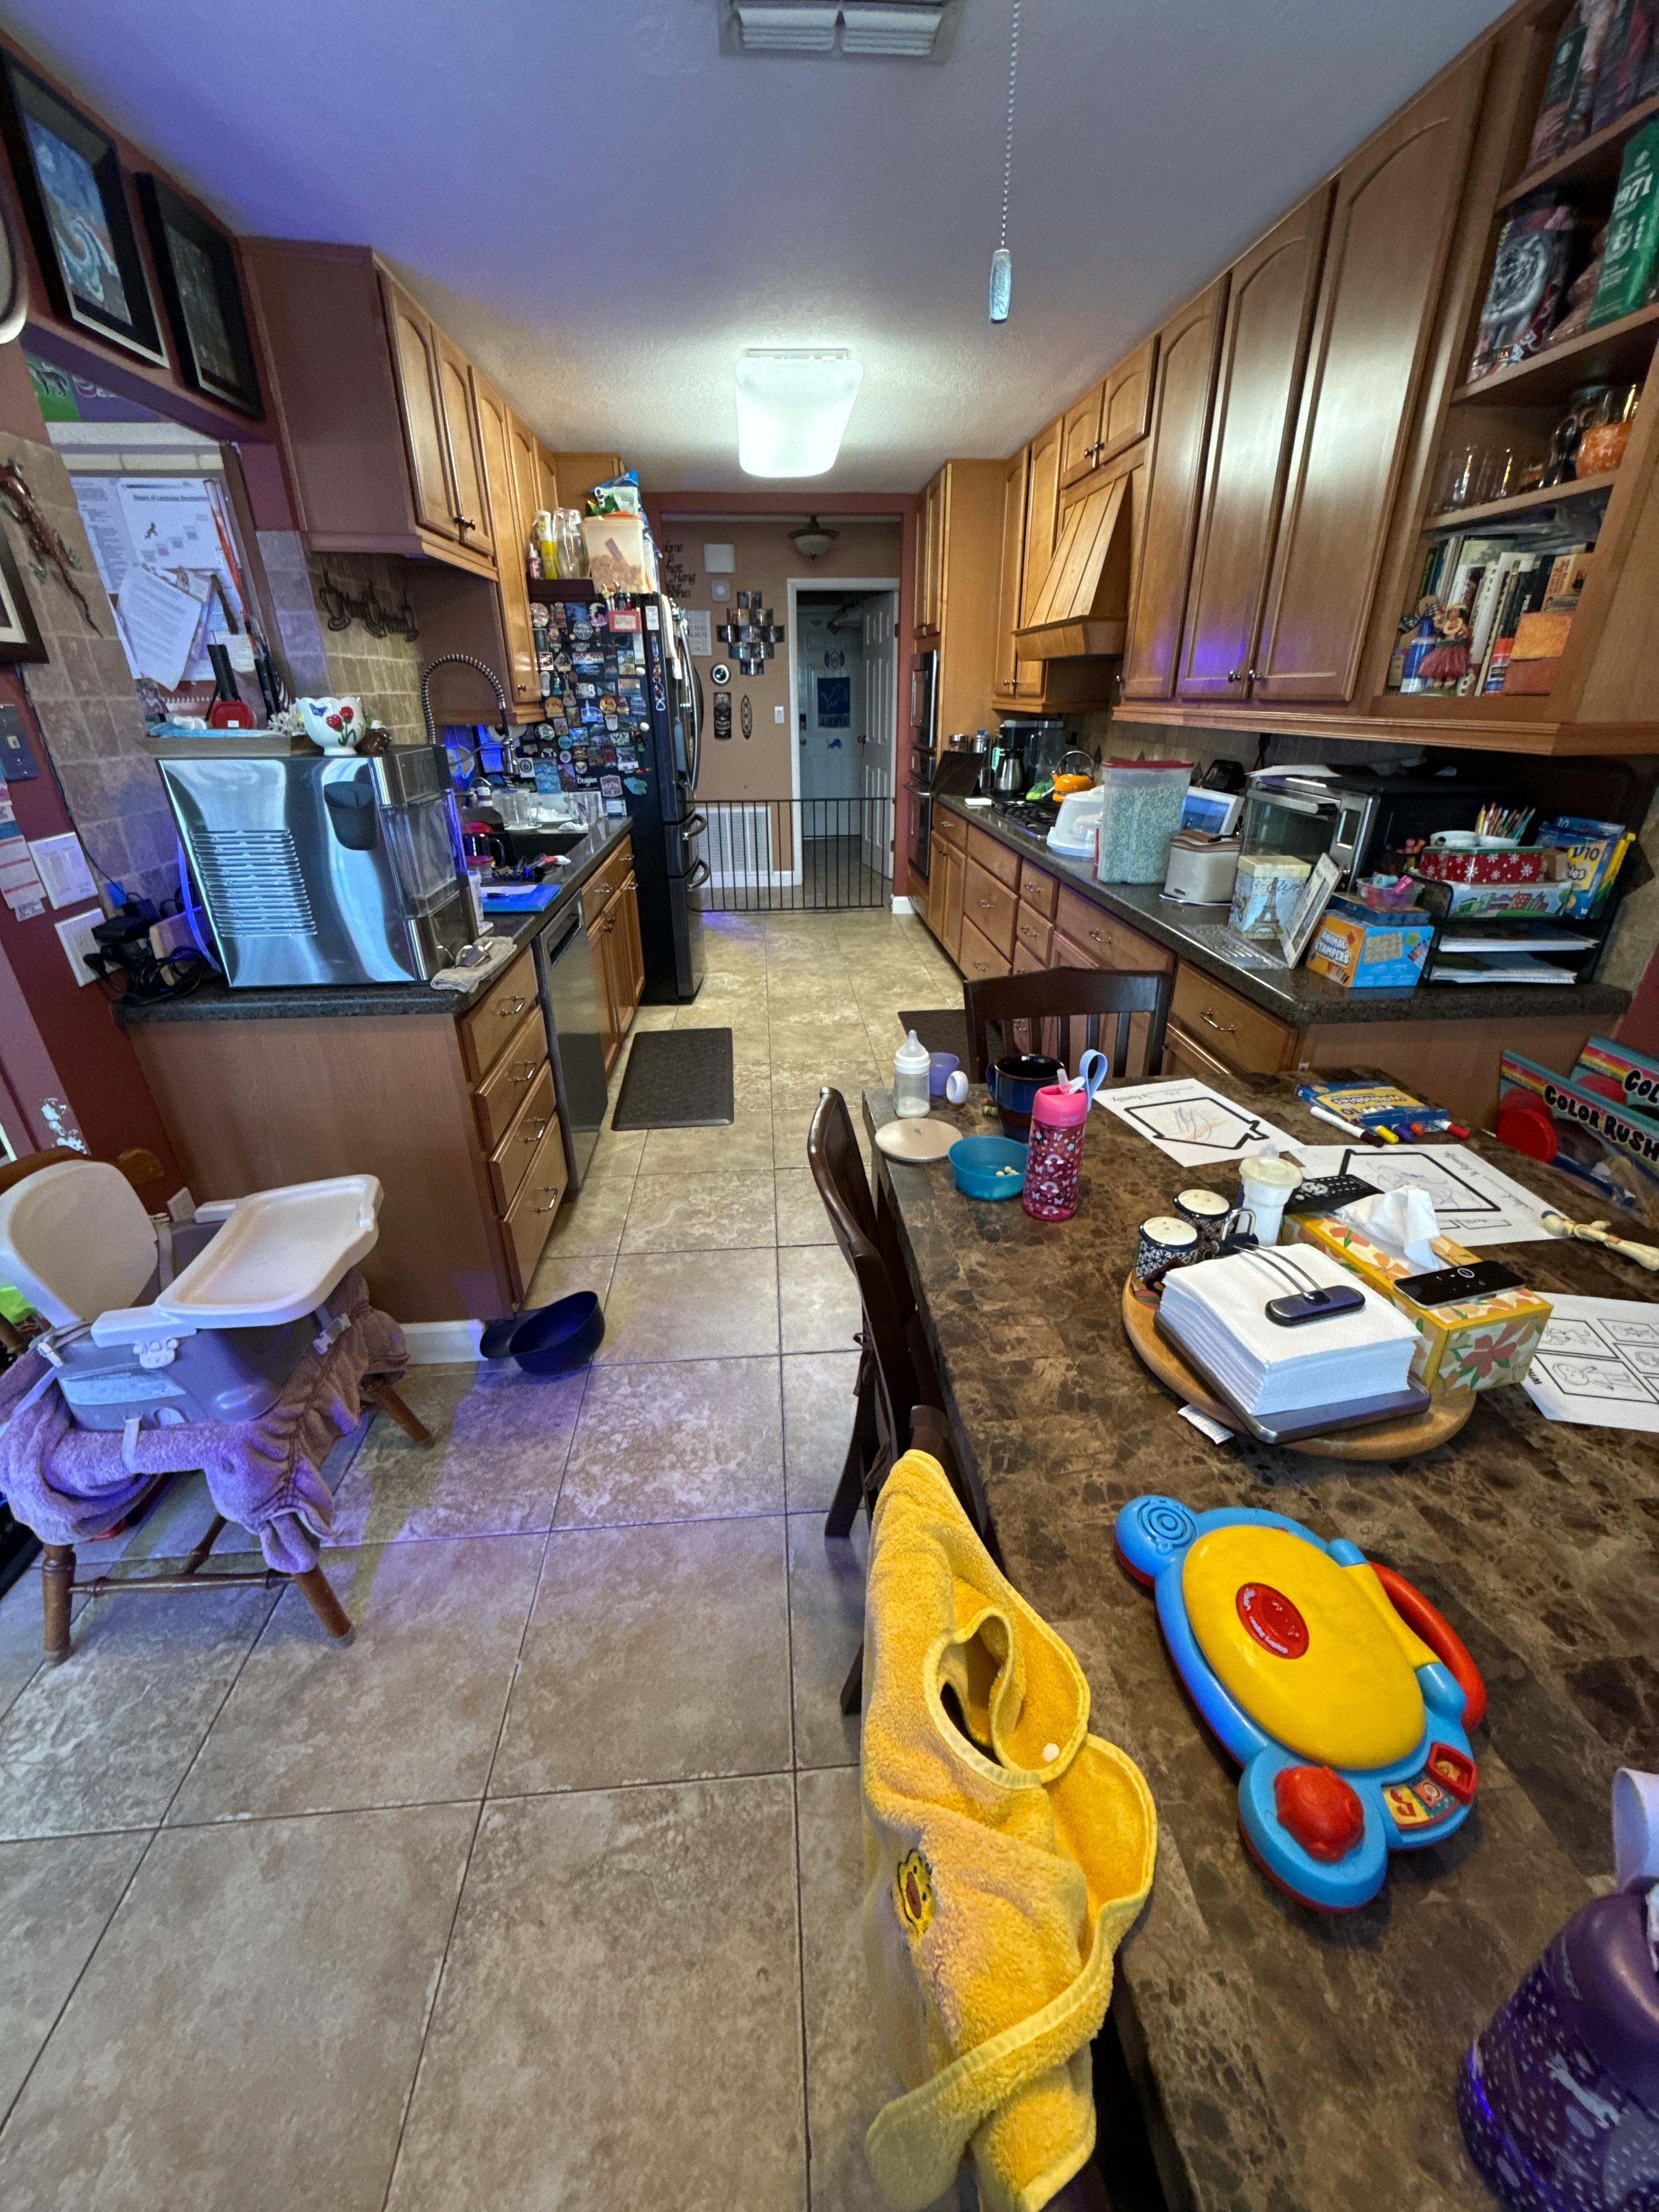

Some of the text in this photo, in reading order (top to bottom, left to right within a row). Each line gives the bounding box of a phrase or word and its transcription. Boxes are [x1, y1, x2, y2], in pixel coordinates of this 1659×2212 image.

[1320, 929, 1347, 950] ANIMAL
[1313, 940, 1351, 965] STAMPERS
[1544, 1085, 1659, 1162] COLOR RUSH
